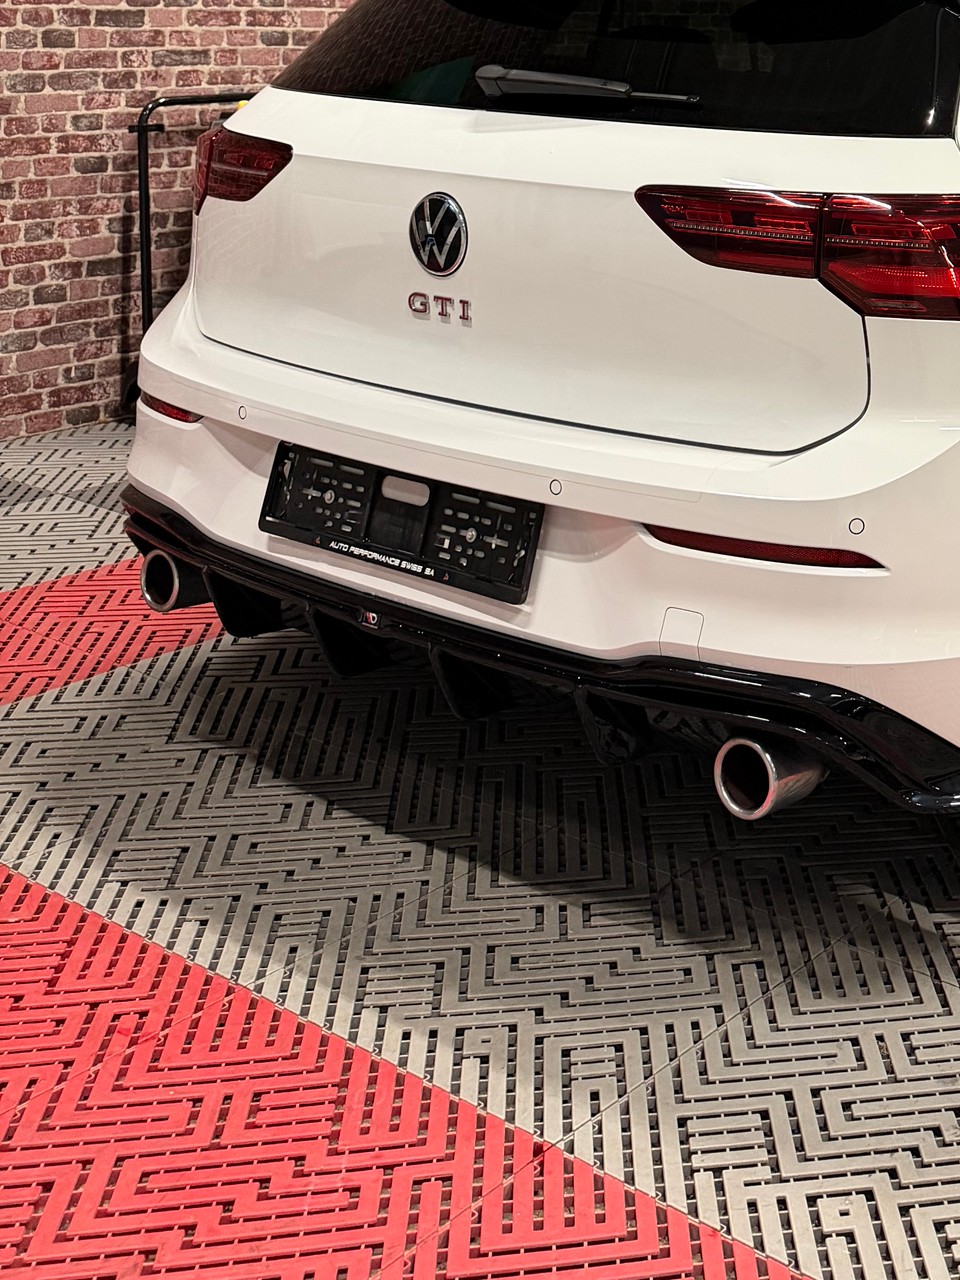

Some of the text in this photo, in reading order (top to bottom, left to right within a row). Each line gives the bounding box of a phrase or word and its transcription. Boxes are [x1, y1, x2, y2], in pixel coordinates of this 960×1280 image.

[408, 291, 470, 322] GTI
[329, 540, 435, 577] AUTO PERFORMANCE SWISS SA
